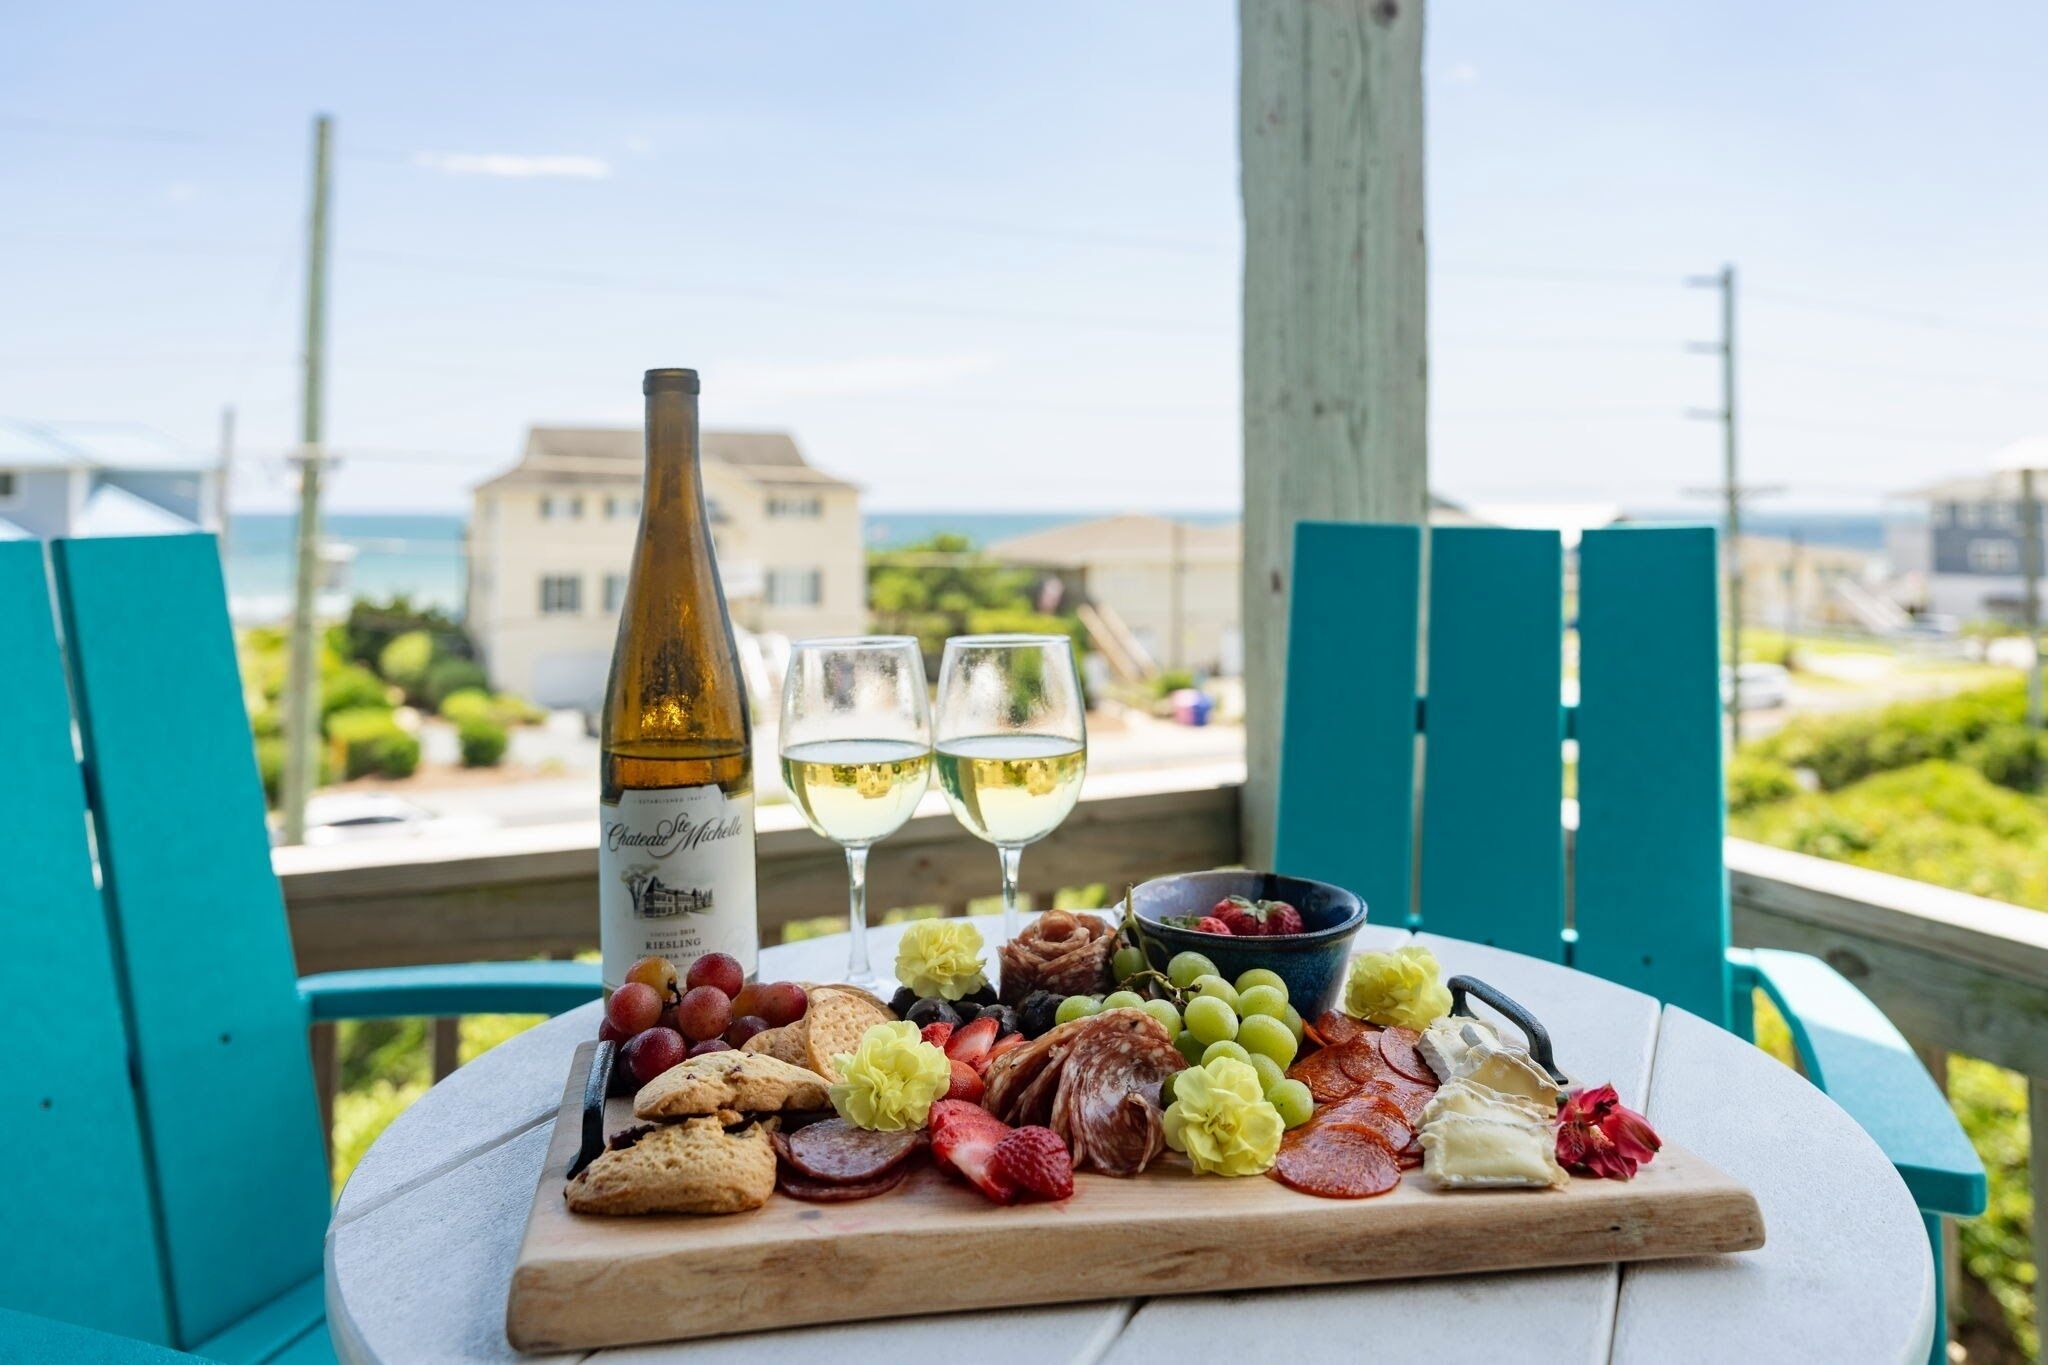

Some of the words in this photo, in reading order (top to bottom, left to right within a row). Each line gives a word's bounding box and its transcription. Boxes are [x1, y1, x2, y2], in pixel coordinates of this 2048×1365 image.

[606, 821, 669, 852] Chateau
[648, 816, 743, 859] Michelle
[656, 812, 691, 837] Ste
[645, 937, 702, 950] RIESLING
